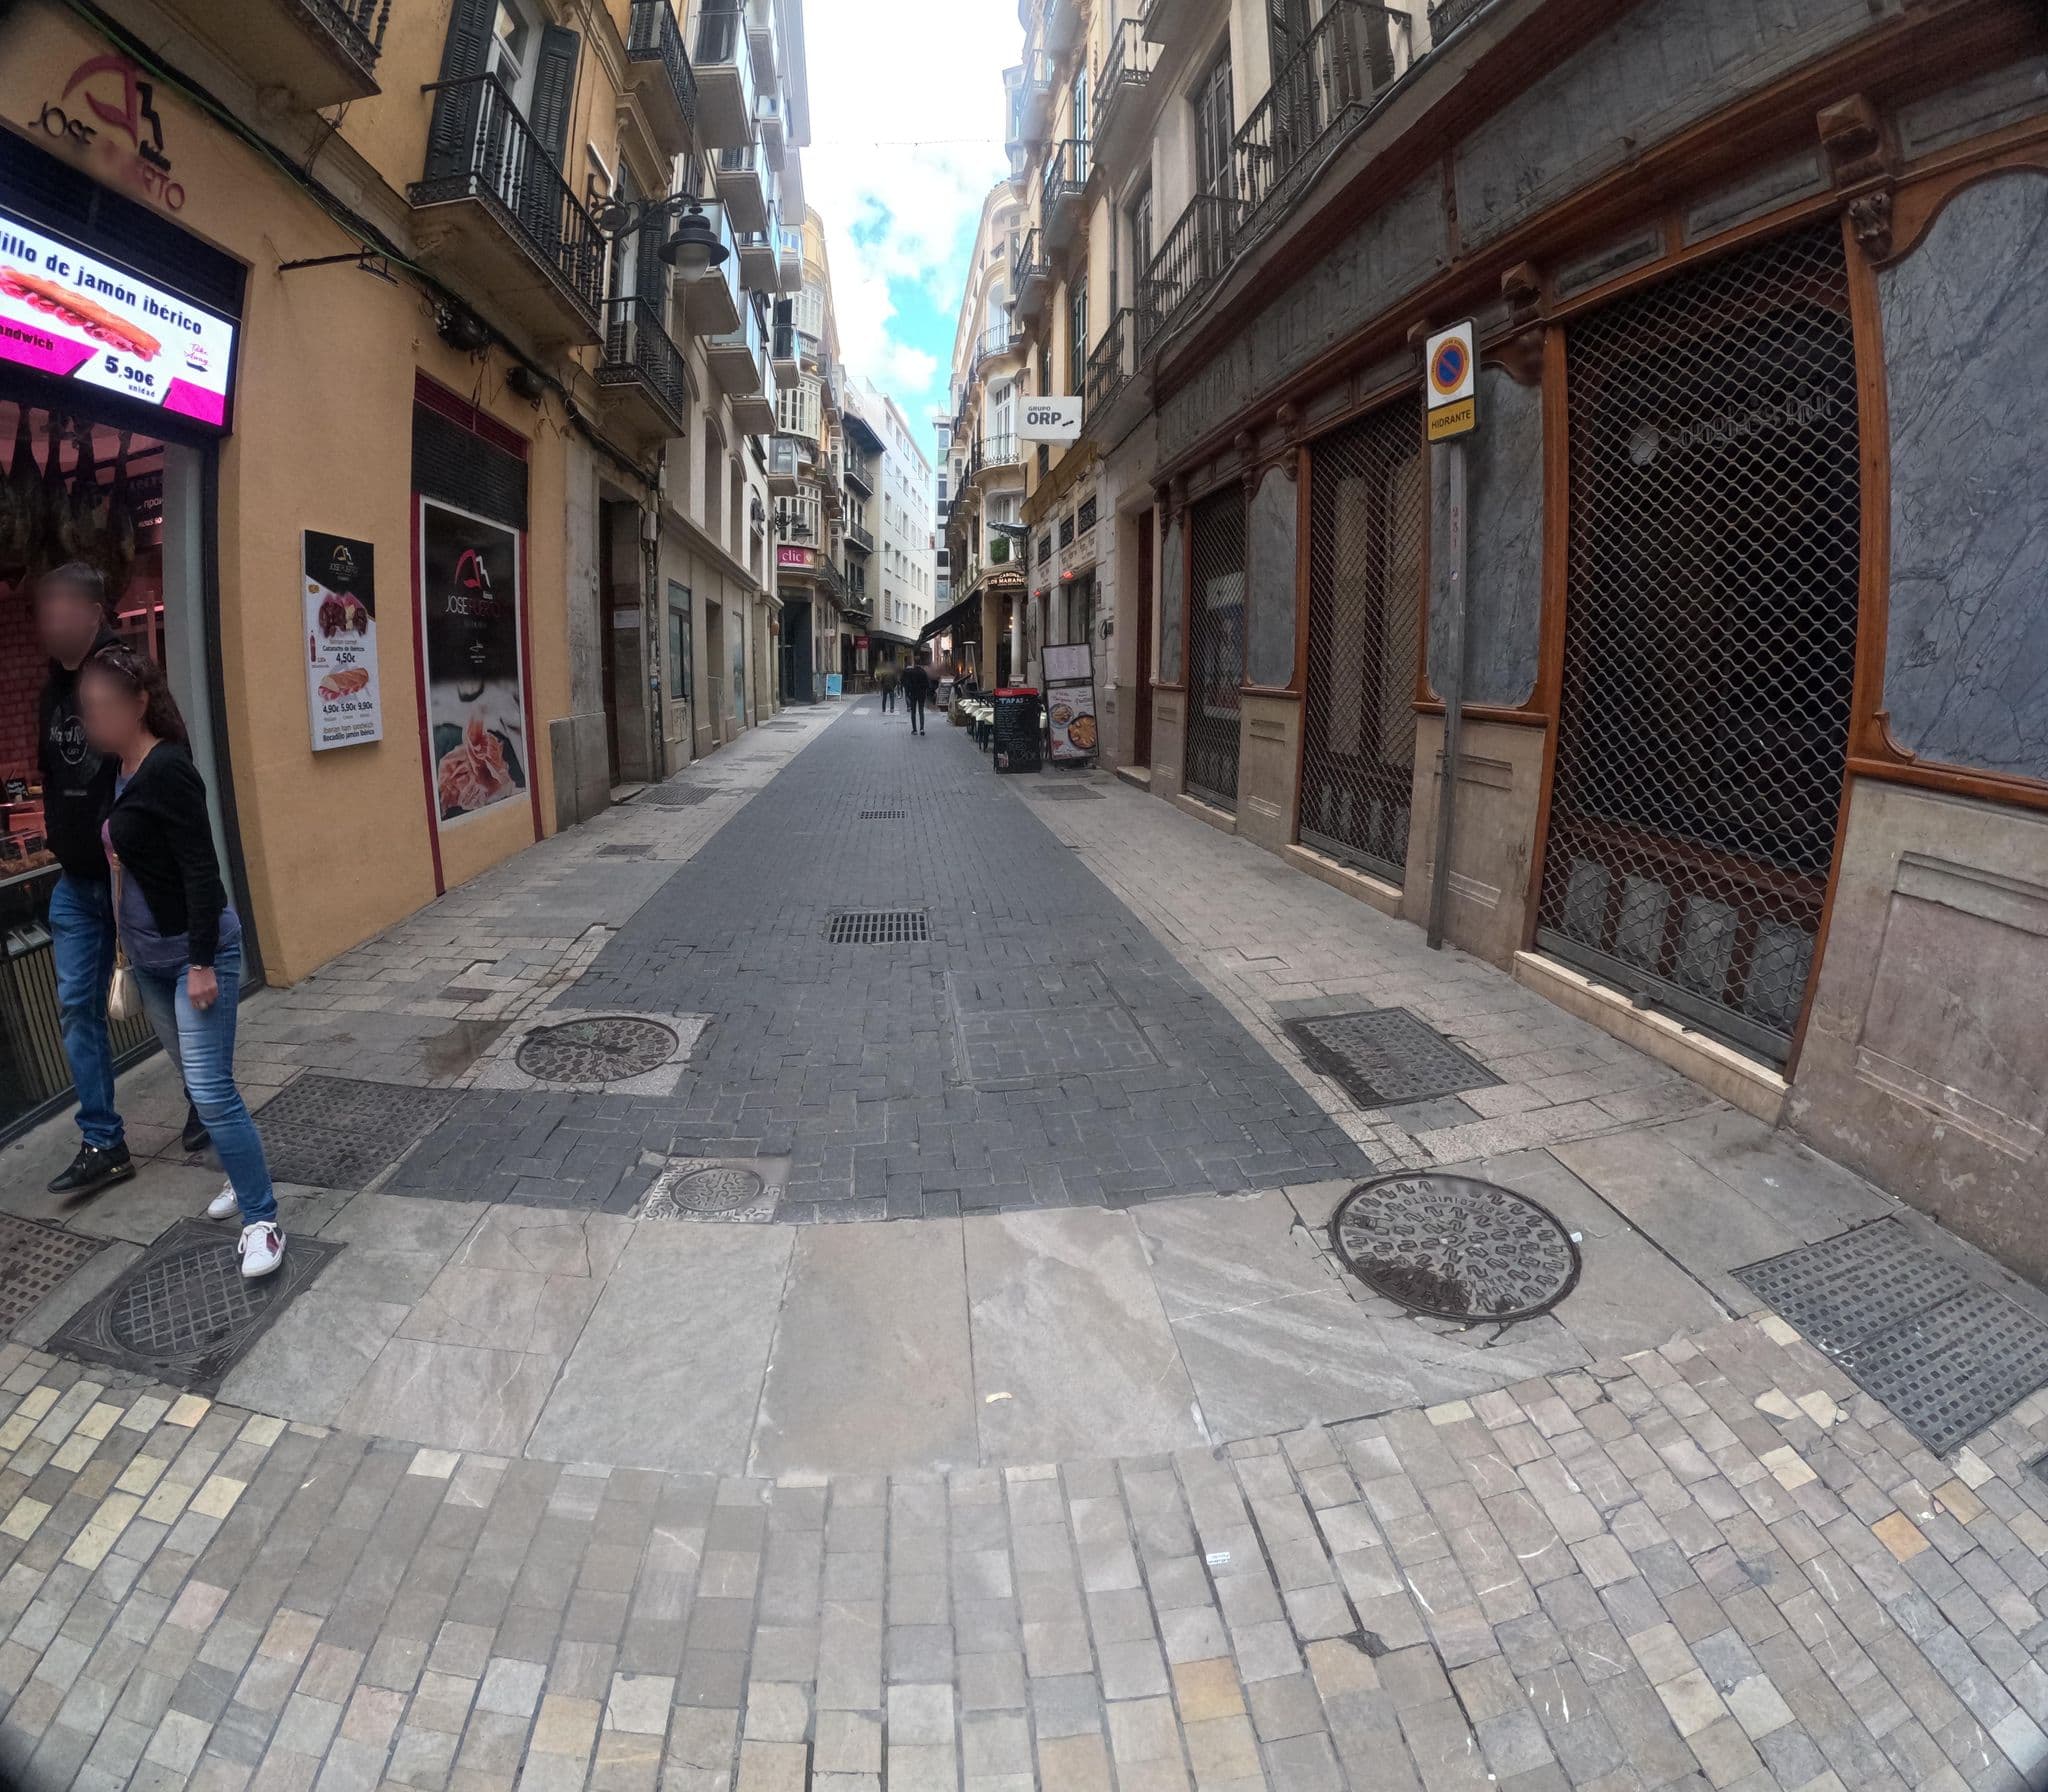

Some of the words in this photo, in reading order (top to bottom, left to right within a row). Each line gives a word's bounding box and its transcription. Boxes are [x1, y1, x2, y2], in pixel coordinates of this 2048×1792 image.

[46, 254, 70, 277] de
[73, 266, 136, 306] jamón
[143, 295, 203, 336] ibérico
[128, 384, 155, 398] unidad
[1027, 412, 1062, 425] ORP
[1431, 409, 1473, 431] HIDRANTE
[782, 549, 802, 562] clic
[445, 592, 469, 616] JOSE
[335, 653, 356, 664] 4,50€
[323, 704, 339, 713] 4,90€
[340, 703, 356, 712] 5,90€
